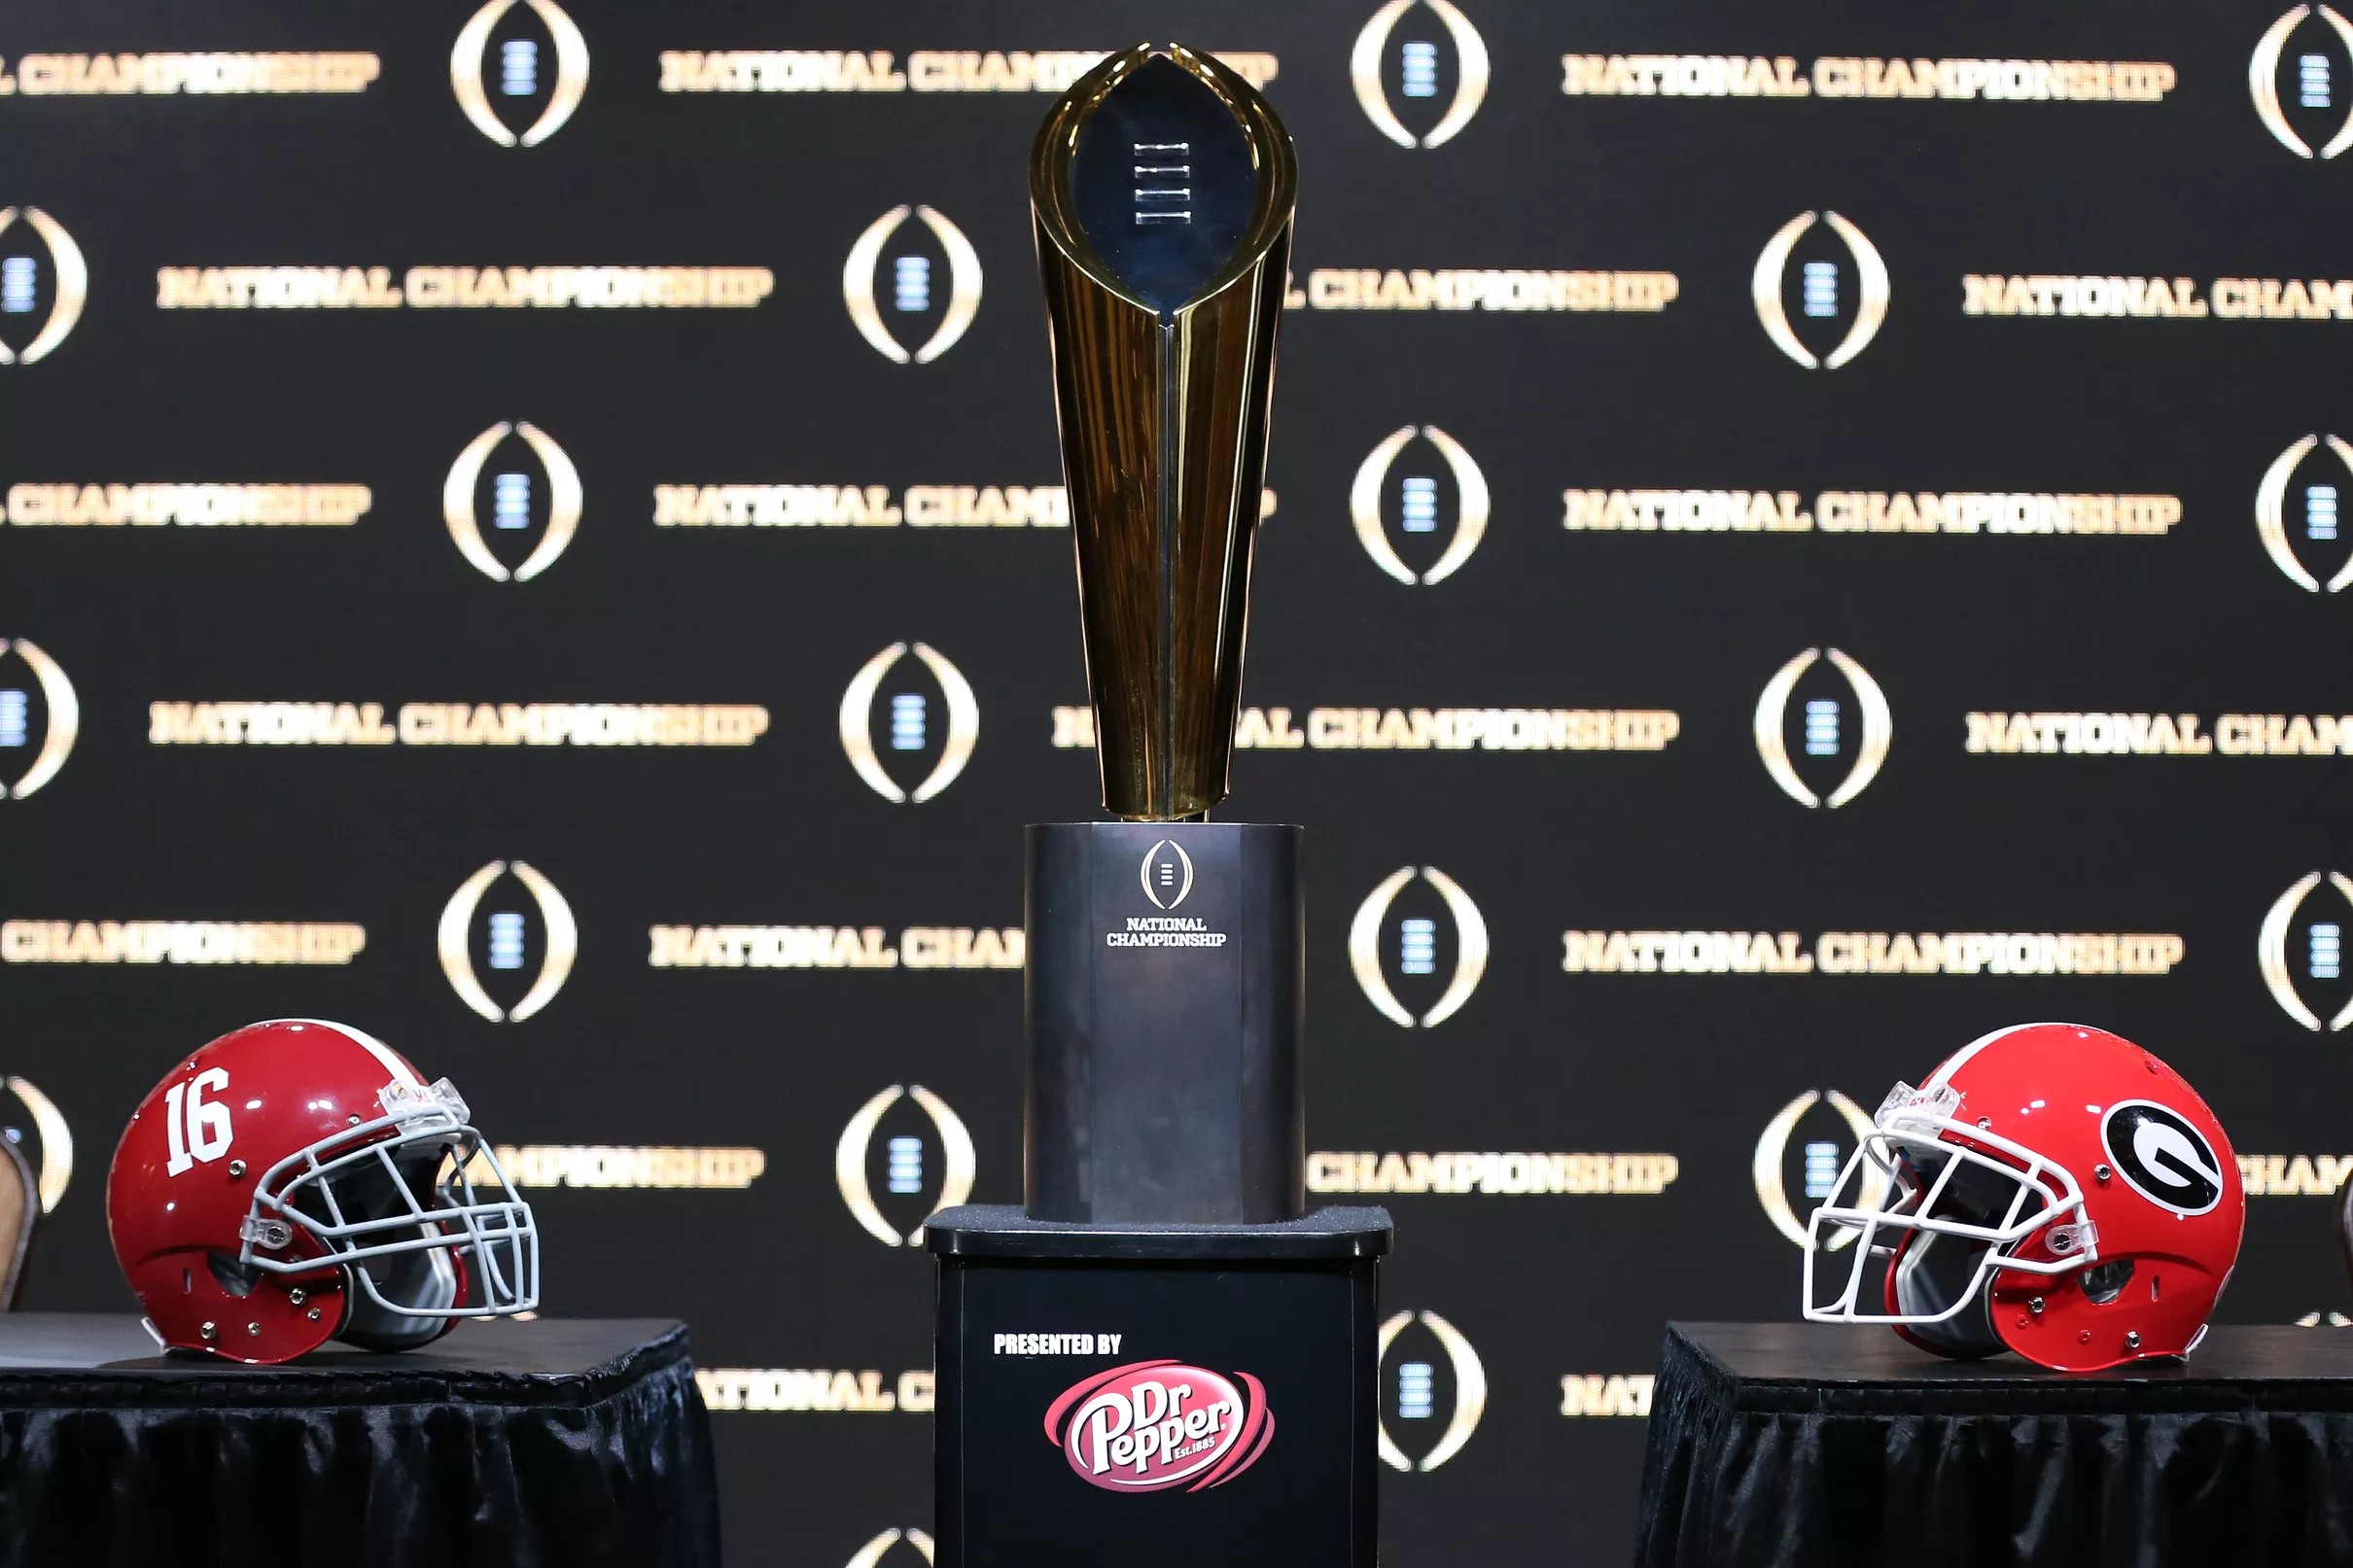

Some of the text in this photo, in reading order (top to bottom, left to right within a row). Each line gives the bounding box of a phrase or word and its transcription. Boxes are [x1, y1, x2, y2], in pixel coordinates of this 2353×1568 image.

[18, 52, 380, 95] CHAMPIONSHIP
[658, 51, 906, 91] NATIONAL
[1562, 54, 2177, 101] NATIONAL CHAMPIONSHIP
[157, 266, 773, 308] NATIONAL CHAMPIONSHIP
[1309, 268, 1679, 311] CHAMPIONSHIP
[1963, 274, 2208, 317] NATIONAL
[8, 483, 371, 526] CHAMPIONSHIP
[652, 484, 901, 527] NATIONAL
[1563, 489, 2183, 535] NATIONAL CHAMPIONSHIP
[149, 701, 768, 746] NATIONAL CHAMPIONSHIP
[1308, 708, 1679, 750] CHAMPIONSHIP
[1965, 712, 2212, 754] NATIONAL
[1, 920, 366, 964] CHAMPIONSHIP
[649, 924, 898, 968] NATIONAL
[1106, 933, 1226, 947] CHAMPIONSHIP
[1126, 918, 1207, 931] NATIONAL
[1563, 930, 2185, 974] NATIONAL CHAMPIONSHIP
[164, 1067, 233, 1177] 16
[1307, 1151, 1678, 1194] CHAMPIONSHIP
[2103, 1101, 2222, 1213] G
[994, 1333, 1122, 1355] PRESENTED BY
[1131, 1380, 1193, 1431] Dr
[1071, 1393, 1231, 1475] Pepper
